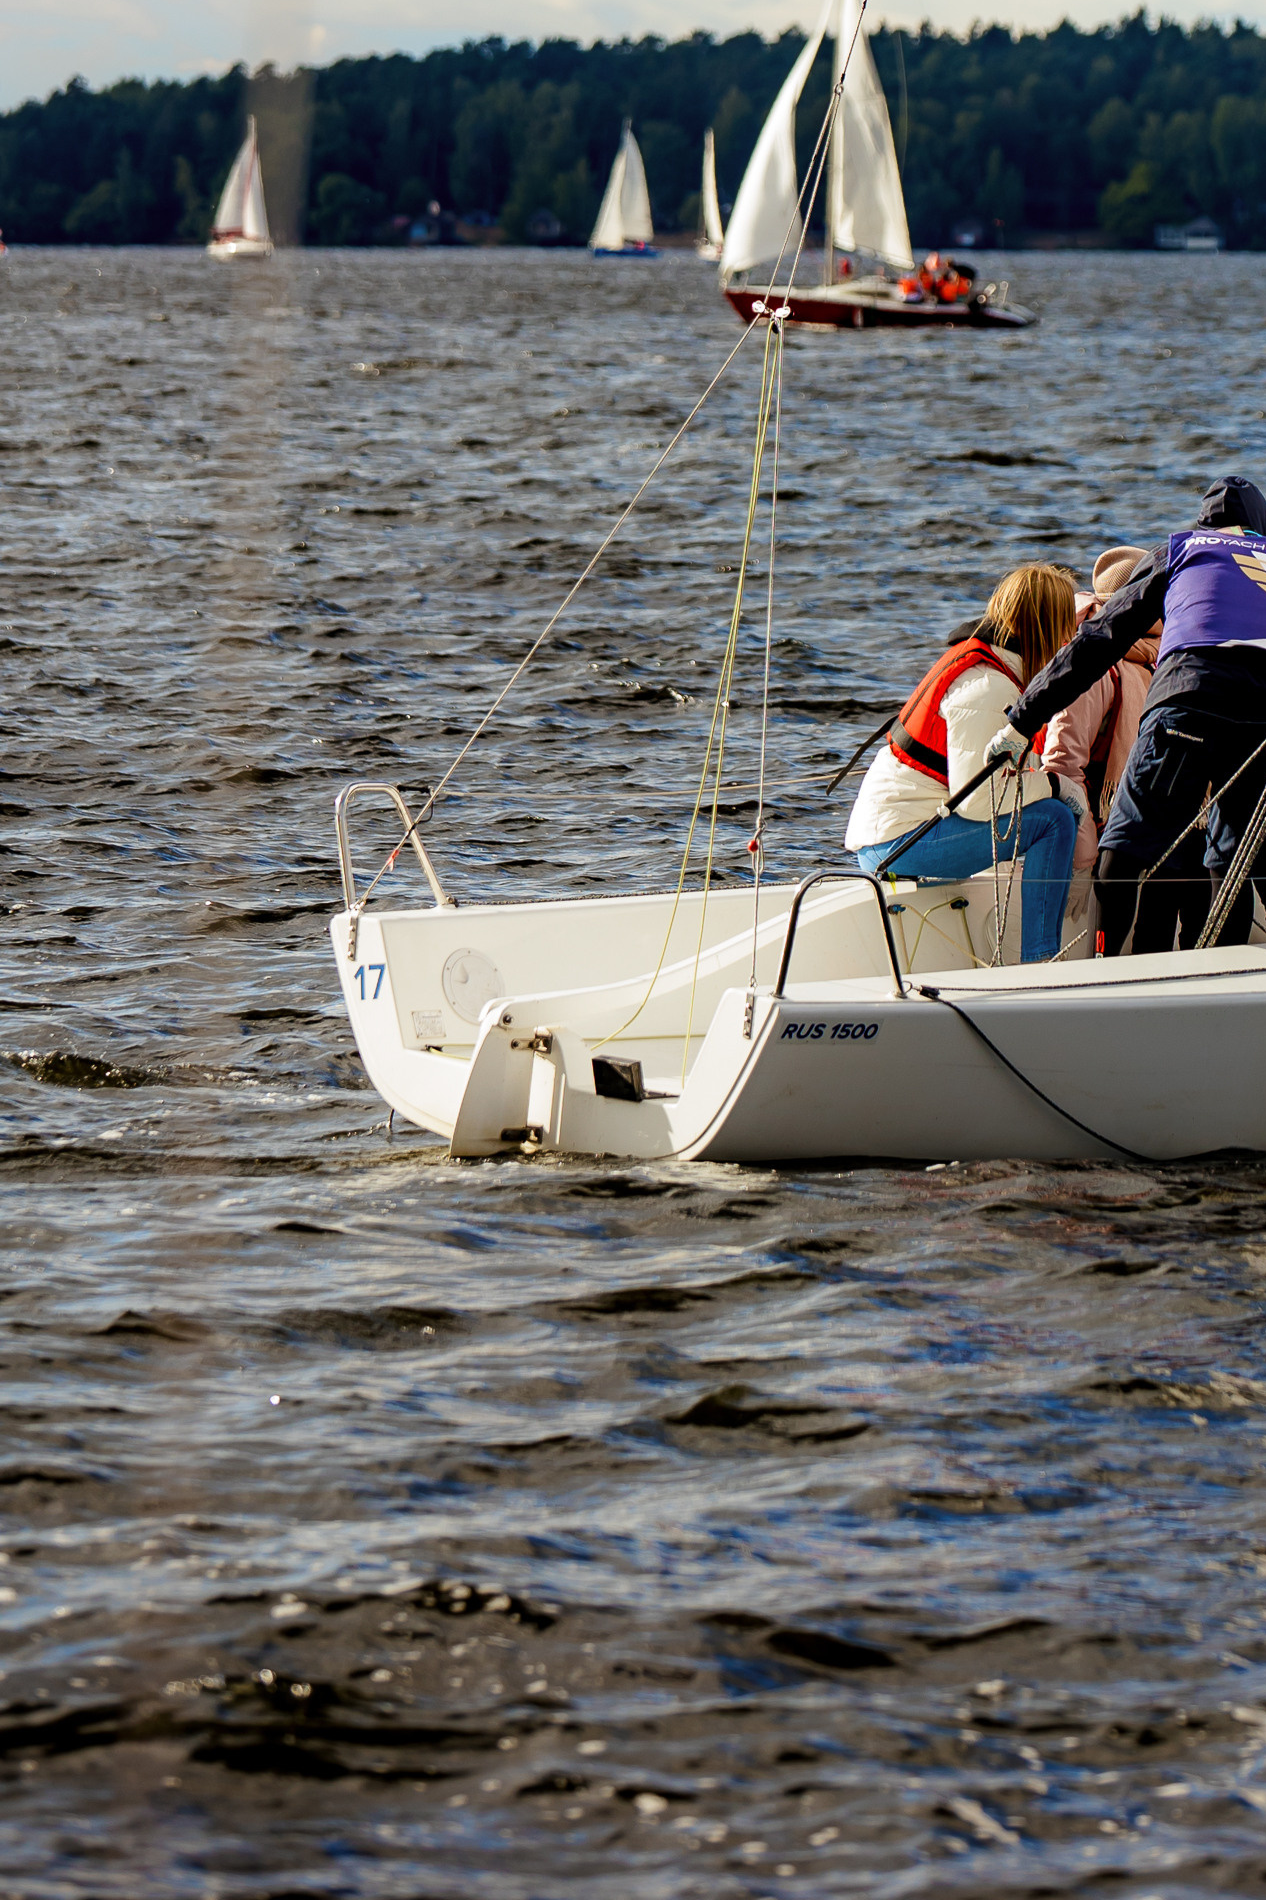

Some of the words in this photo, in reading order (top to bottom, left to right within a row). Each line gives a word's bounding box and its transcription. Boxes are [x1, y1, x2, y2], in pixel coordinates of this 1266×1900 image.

[354, 964, 386, 1001] 17
[781, 1023, 827, 1039] RUS
[830, 1023, 879, 1039] 1500
